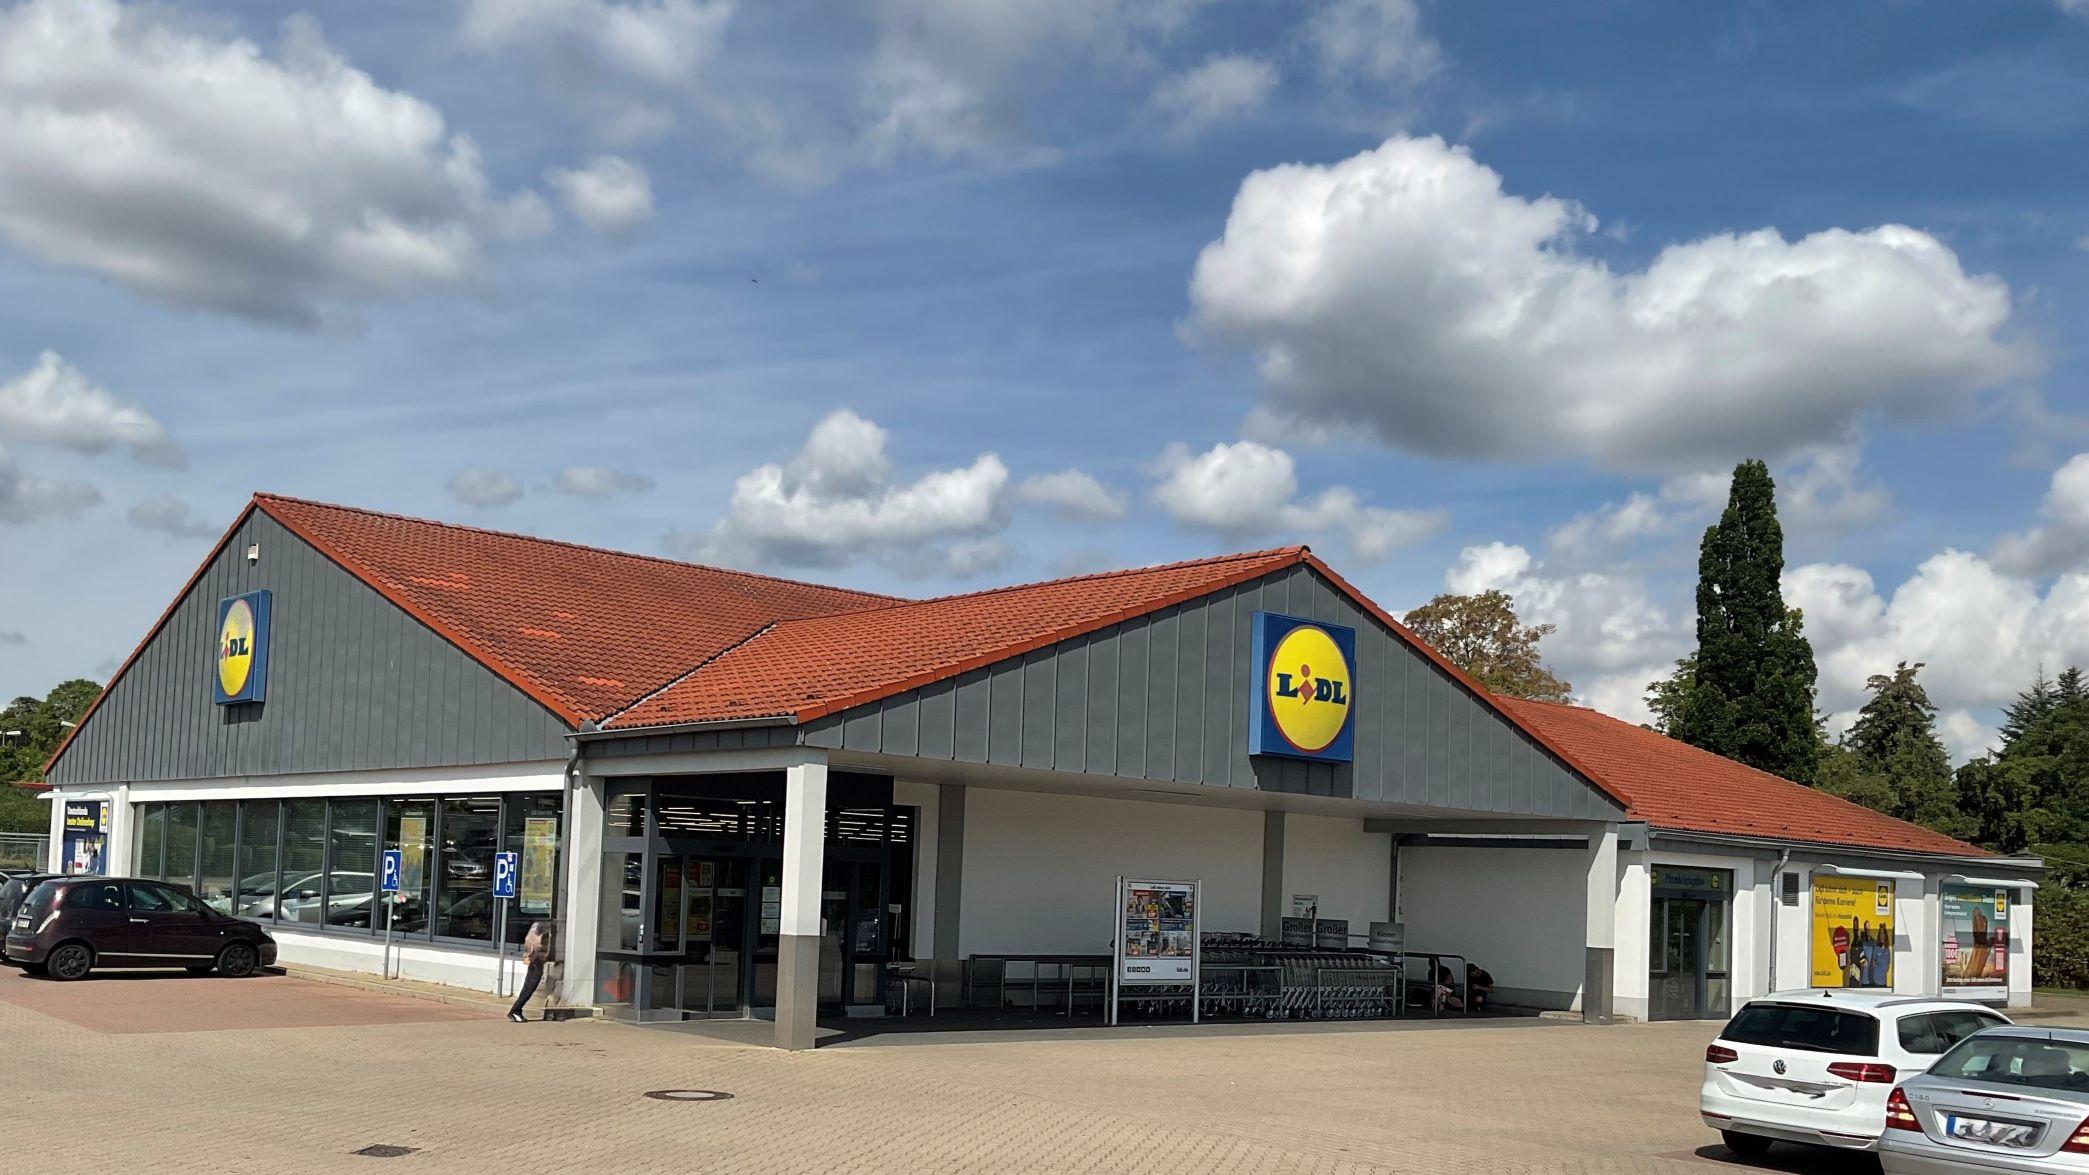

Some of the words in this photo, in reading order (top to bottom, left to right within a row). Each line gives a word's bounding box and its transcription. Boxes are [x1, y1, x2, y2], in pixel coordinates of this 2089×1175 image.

[219, 631, 249, 662] LIDL
[1276, 664, 1346, 705] LIDL
[383, 856, 394, 885] P
[496, 858, 508, 890] P
[1317, 922, 1347, 935] Großer
